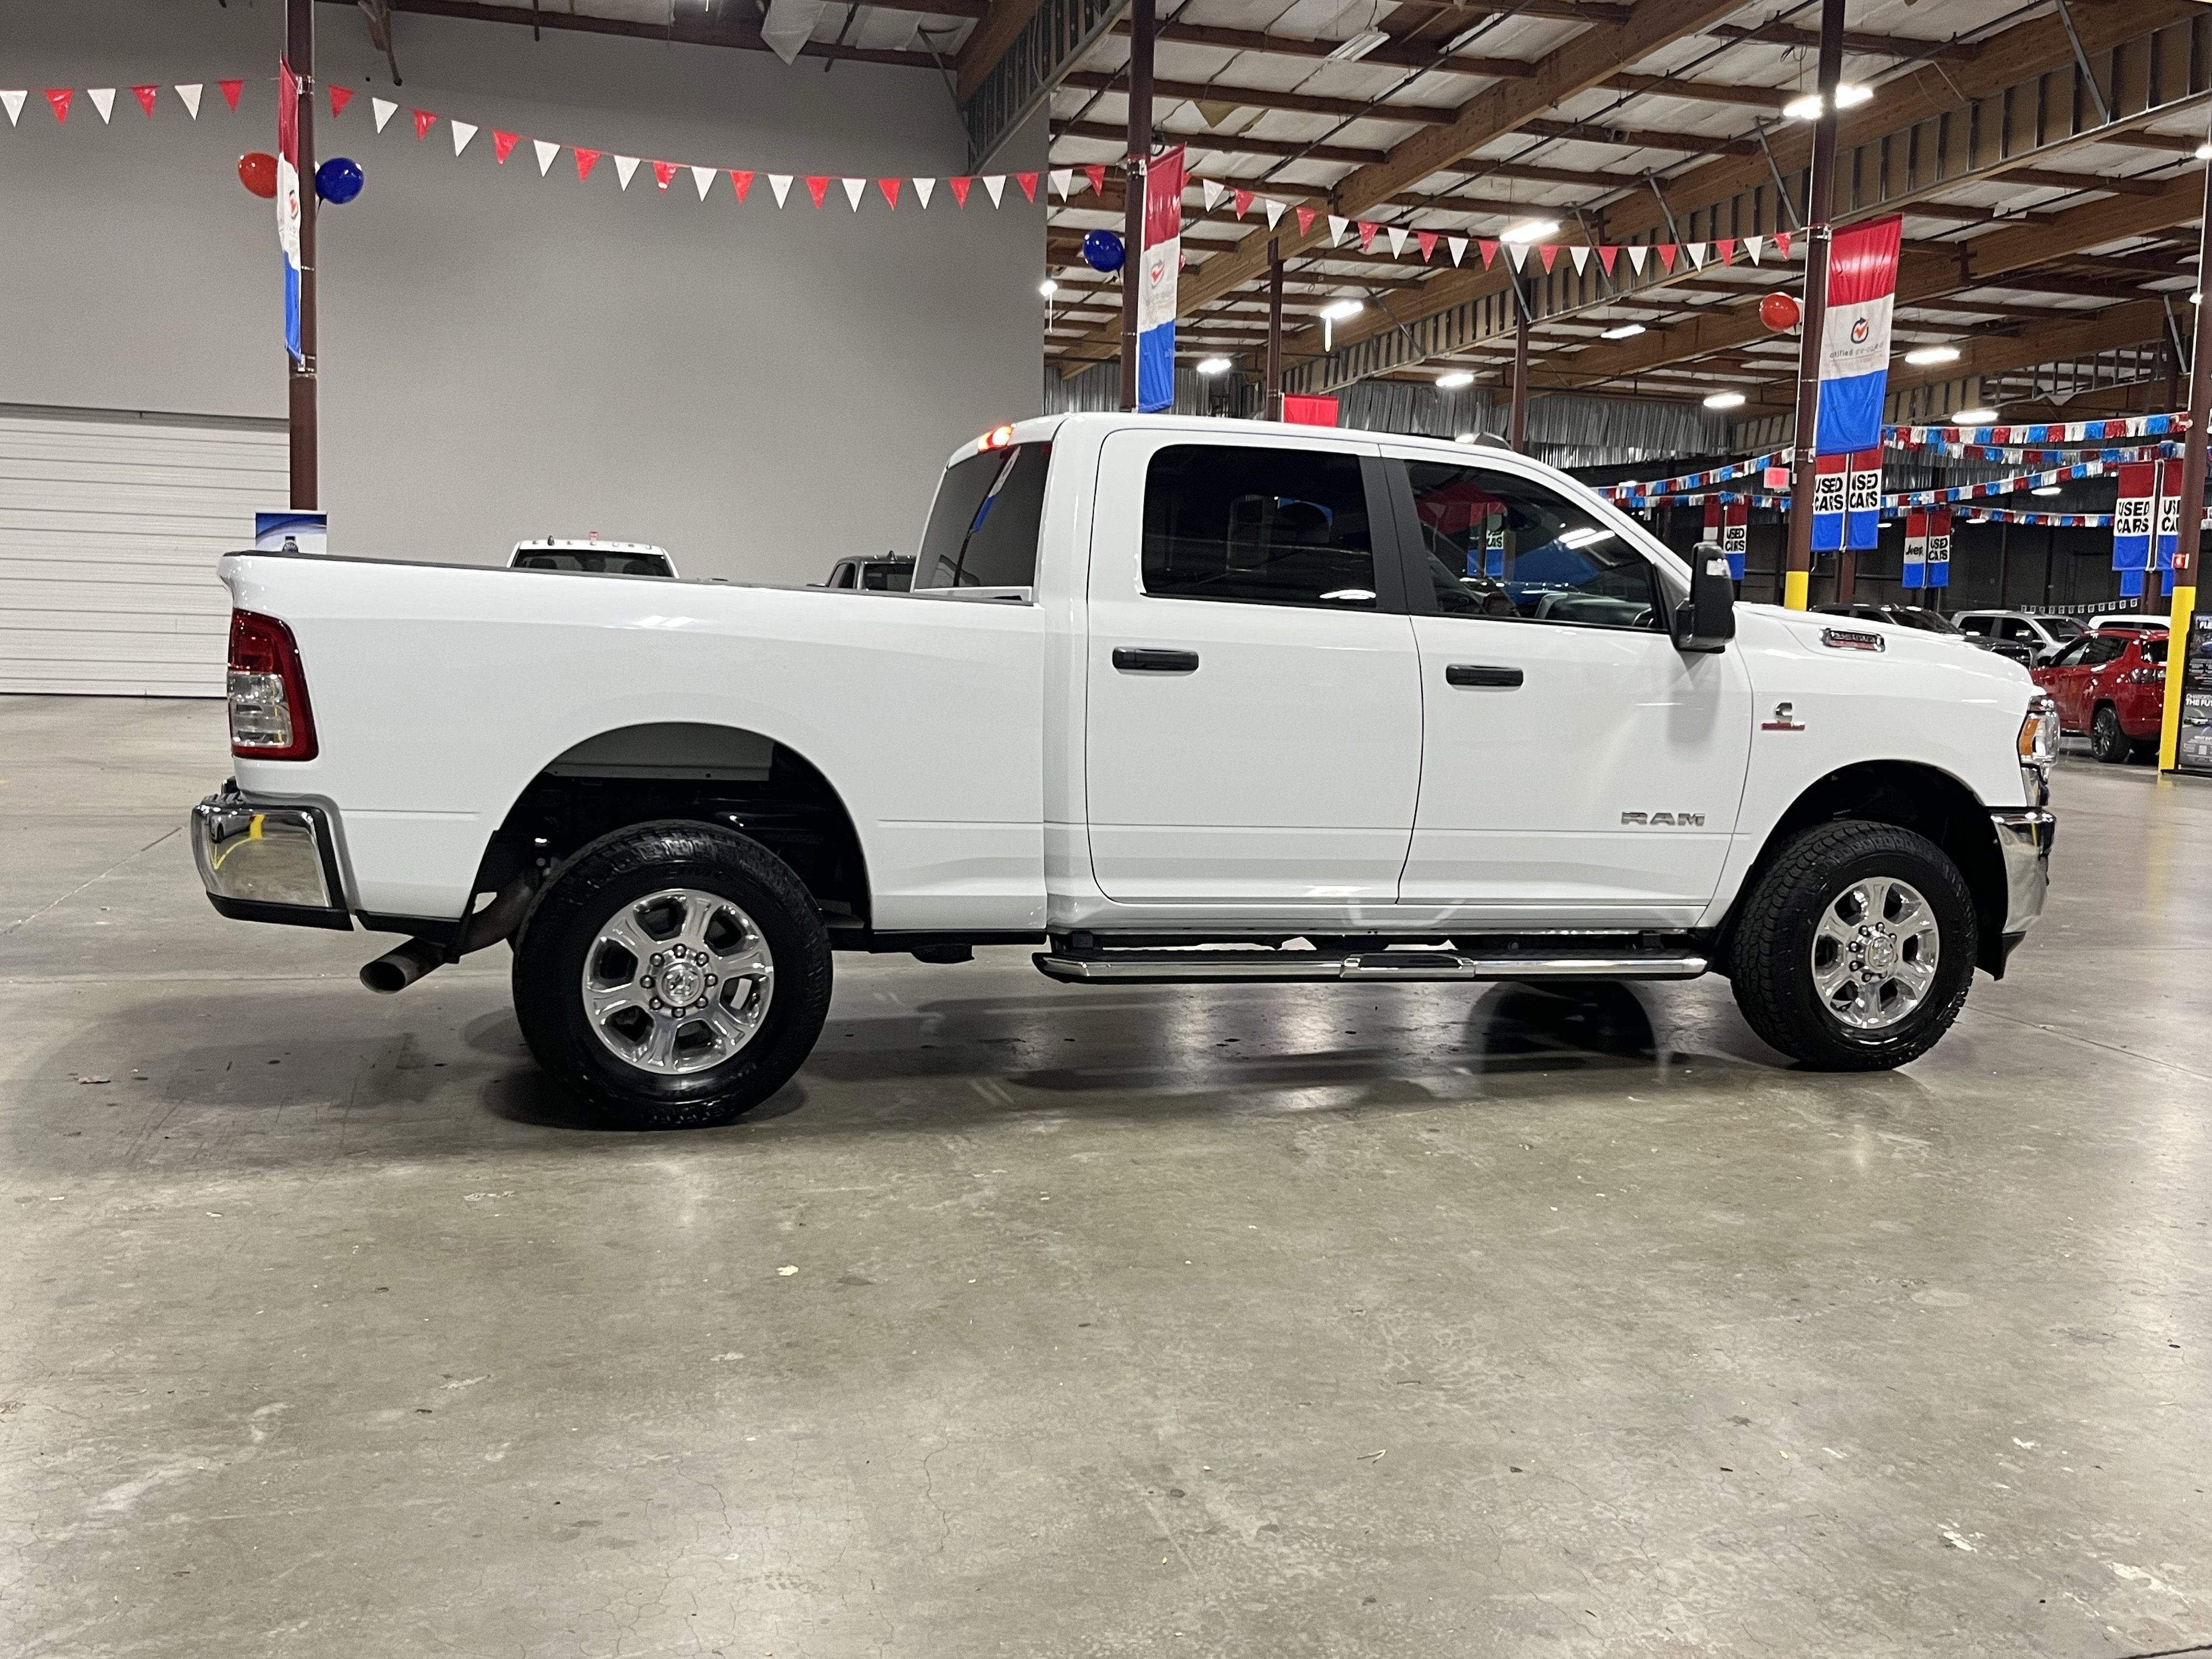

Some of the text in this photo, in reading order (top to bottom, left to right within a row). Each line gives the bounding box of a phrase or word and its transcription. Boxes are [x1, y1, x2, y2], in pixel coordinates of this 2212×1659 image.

[1815, 477, 1843, 494] USED
[1852, 473, 1878, 491] USED
[2118, 501, 2150, 516] USED
[2117, 517, 2149, 533] CARS
[1726, 528, 1745, 539] USED
[1930, 538, 1948, 549] USED
[2185, 698, 2212, 707] THE FU
[1621, 811, 1706, 827] RAM
